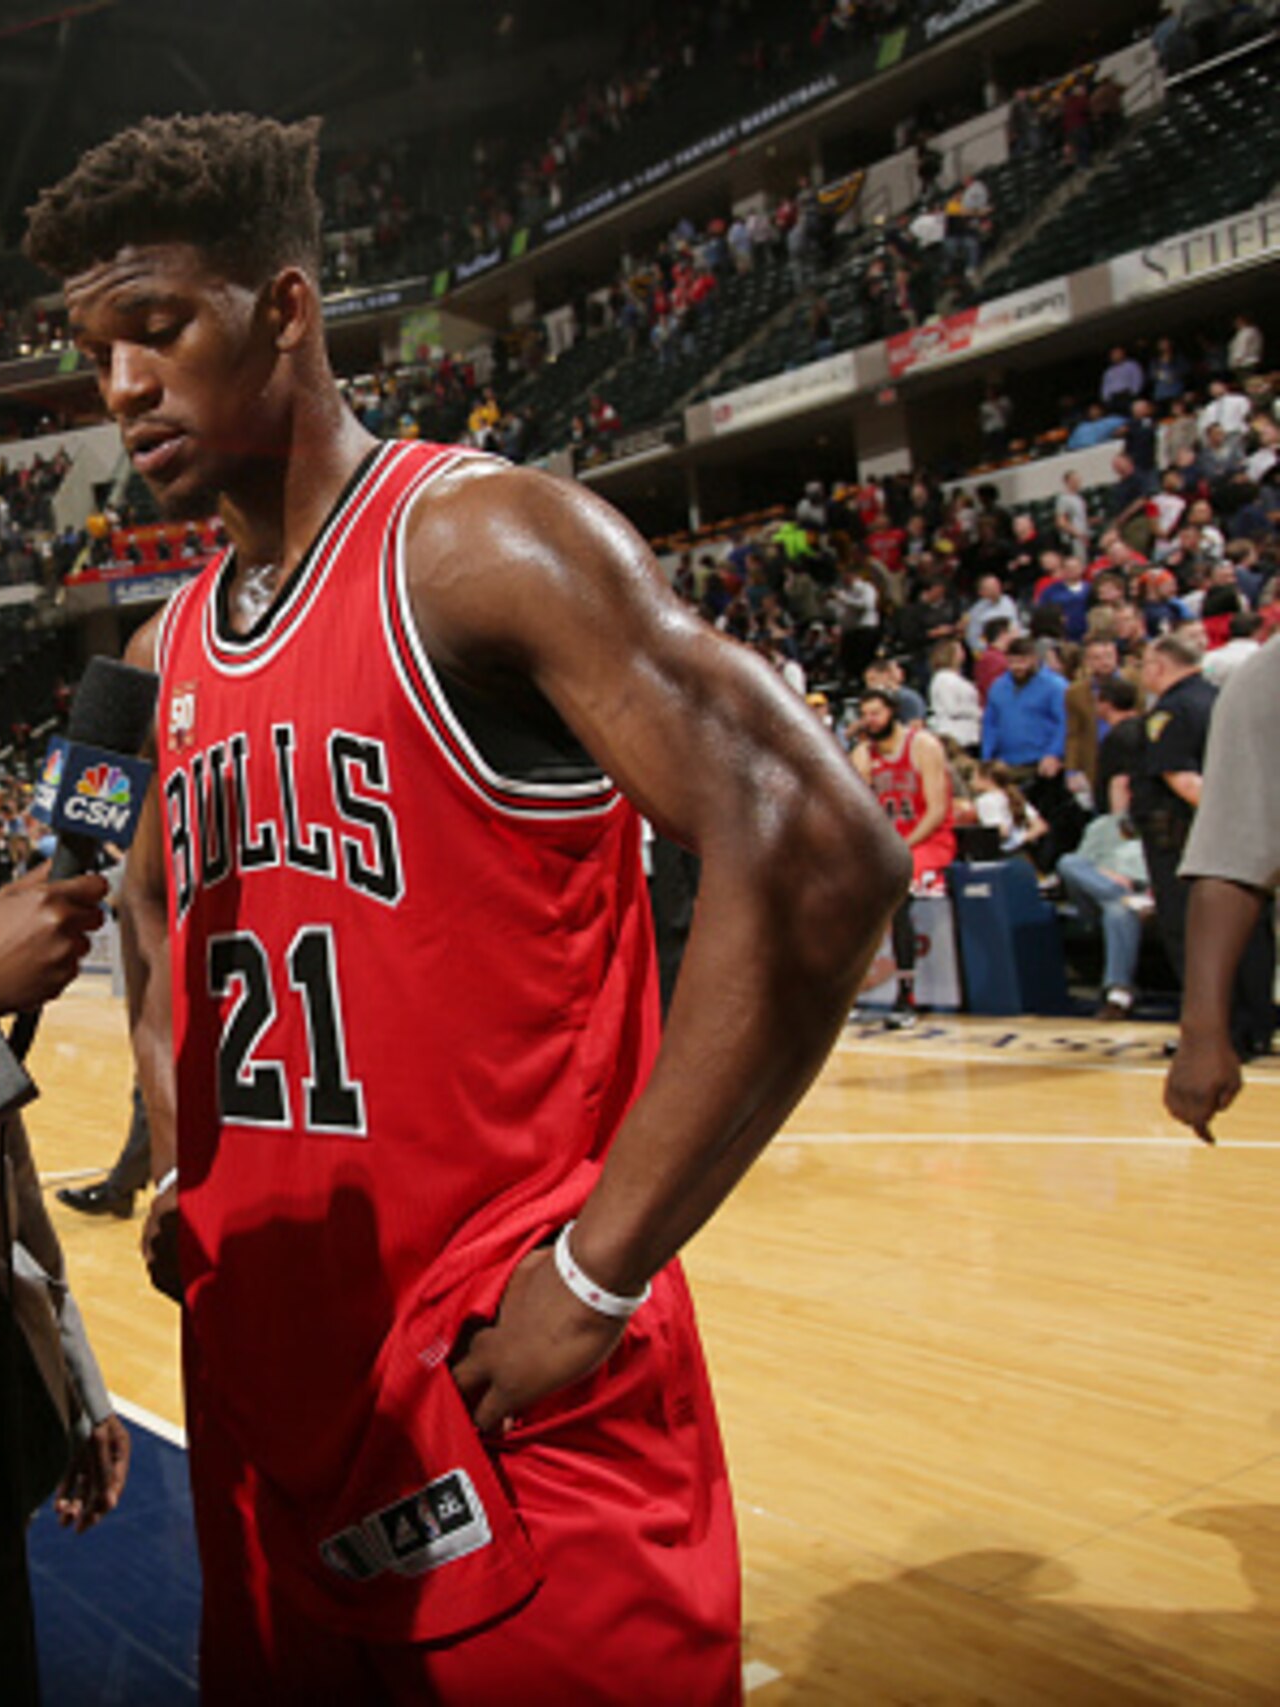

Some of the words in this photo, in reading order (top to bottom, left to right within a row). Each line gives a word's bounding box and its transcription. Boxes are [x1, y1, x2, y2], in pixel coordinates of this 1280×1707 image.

[675, 127, 738, 166] FANTASY
[740, 74, 837, 134] BASKETBALL
[64, 796, 130, 832] CSN
[164, 723, 406, 932] BULLS
[207, 923, 369, 1138] 21
